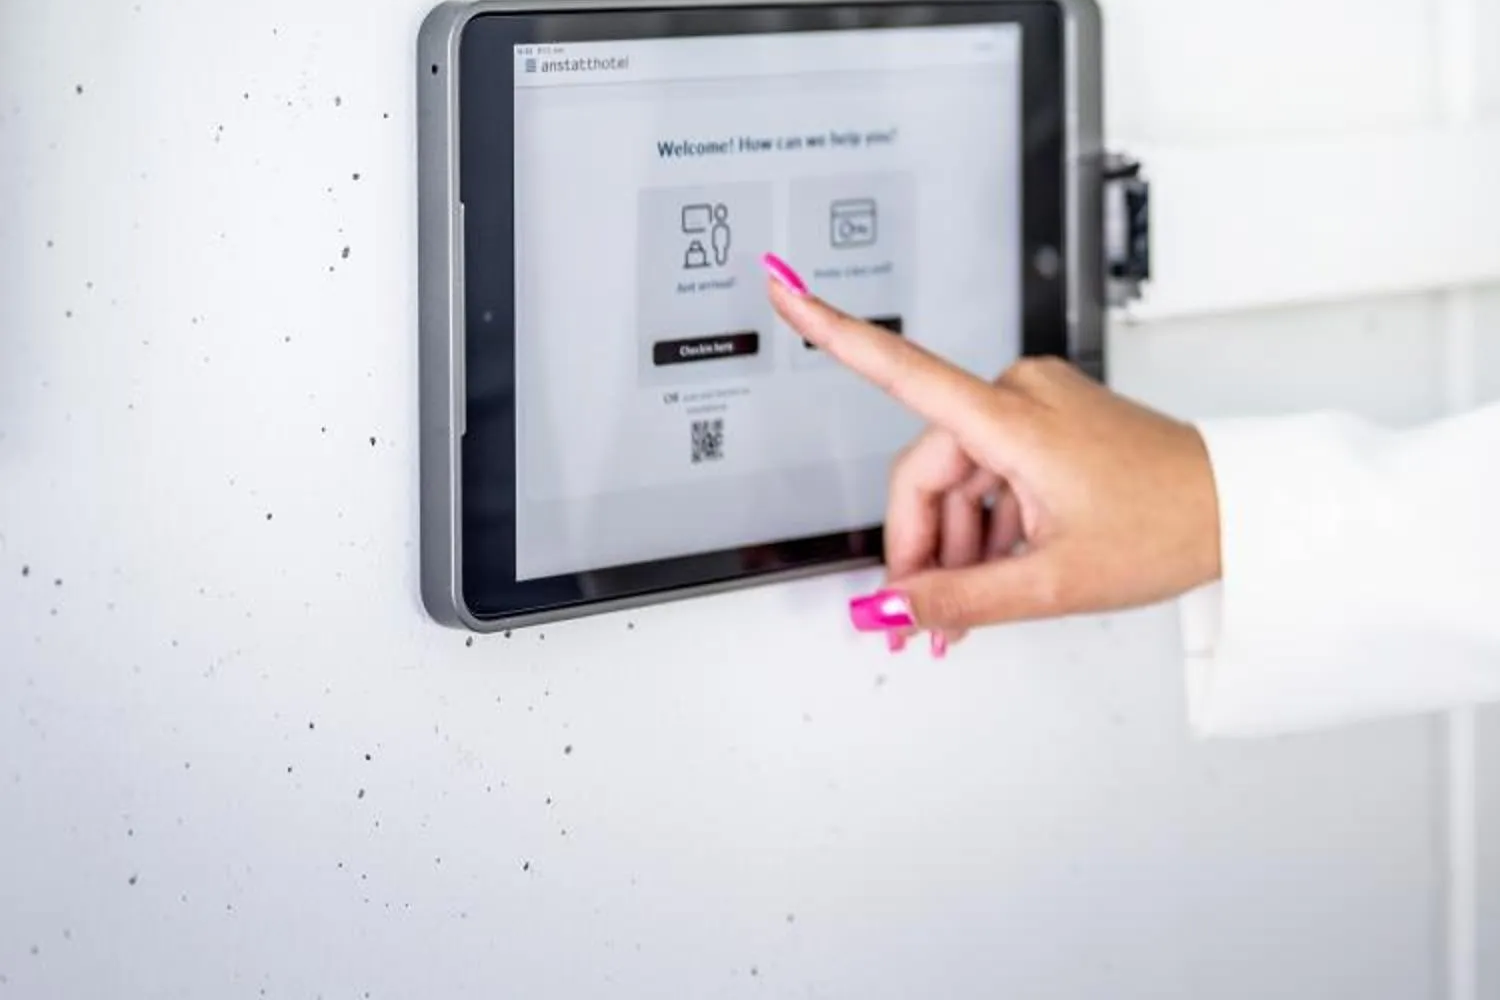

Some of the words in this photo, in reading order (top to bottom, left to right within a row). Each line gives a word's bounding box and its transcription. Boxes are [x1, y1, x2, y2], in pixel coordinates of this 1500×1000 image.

[540, 55, 630, 73] anstatthotel
[656, 136, 735, 158] Welcome!
[738, 135, 773, 152] How
